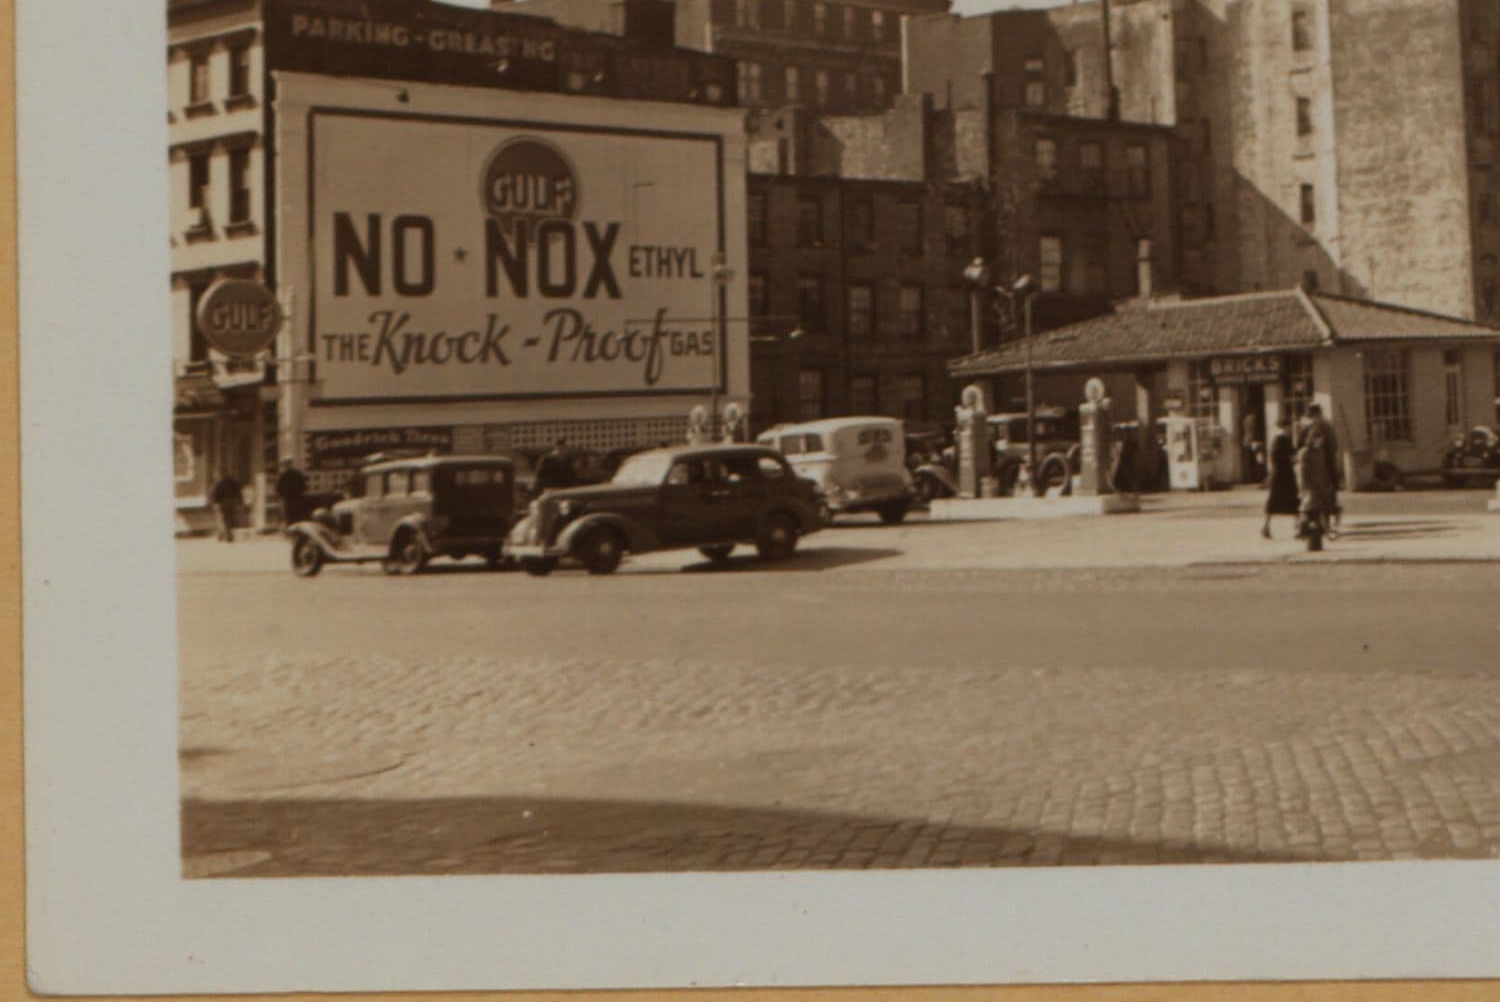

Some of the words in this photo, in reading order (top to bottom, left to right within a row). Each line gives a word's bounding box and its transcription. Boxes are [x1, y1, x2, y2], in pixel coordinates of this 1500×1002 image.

[291, 14, 409, 46] PARKING
[490, 173, 573, 216] GULF
[333, 211, 436, 298] NO
[485, 216, 623, 299] NOX
[629, 245, 704, 279] ETHYL
[209, 301, 273, 333] GULF
[322, 333, 370, 361] THE
[670, 330, 714, 357] GAS
